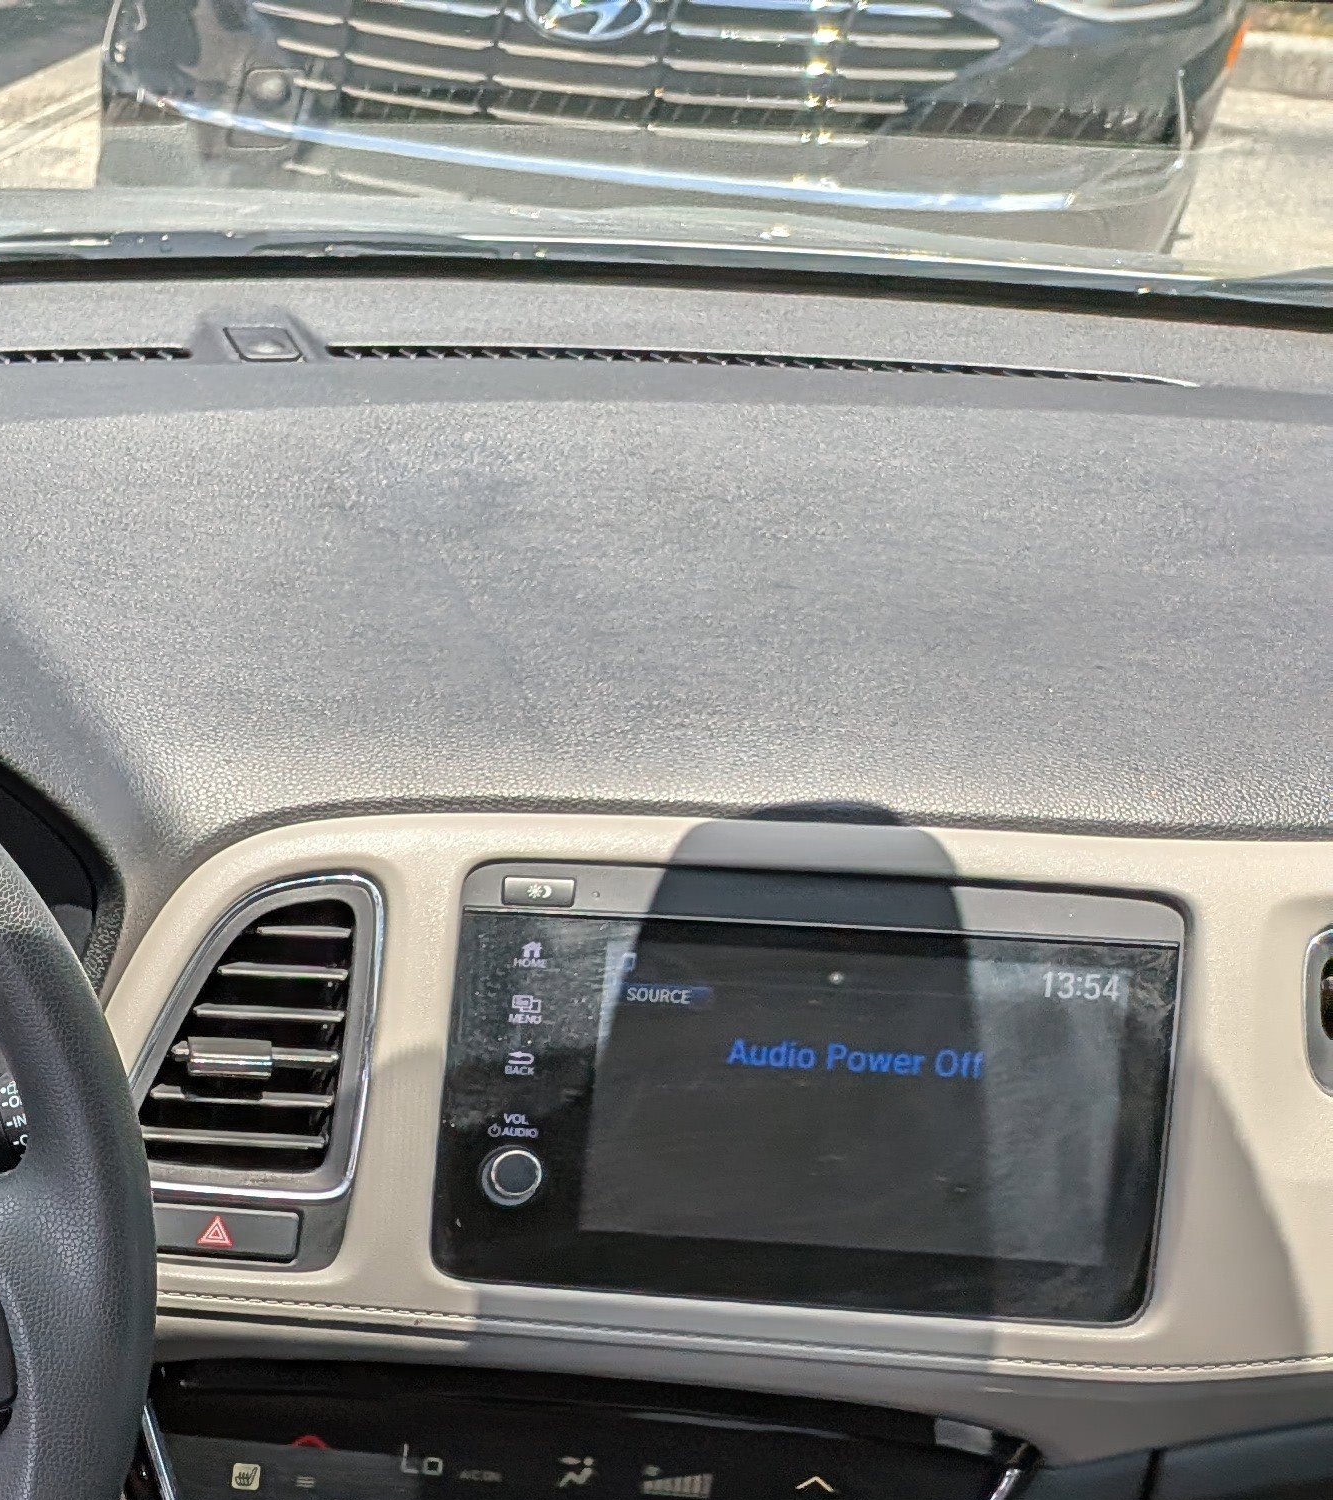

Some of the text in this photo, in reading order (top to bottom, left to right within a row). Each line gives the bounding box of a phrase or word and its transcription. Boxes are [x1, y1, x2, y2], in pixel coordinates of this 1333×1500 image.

[513, 957, 547, 969] HOME
[1042, 971, 1120, 1001] 13:54
[626, 986, 691, 1005] SOURCE
[508, 1013, 543, 1025] MENU
[727, 1037, 985, 1080] Audio Power Off
[504, 1065, 535, 1076] BACK
[503, 1113, 530, 1126] VOL
[502, 1127, 540, 1139] AUDIO
